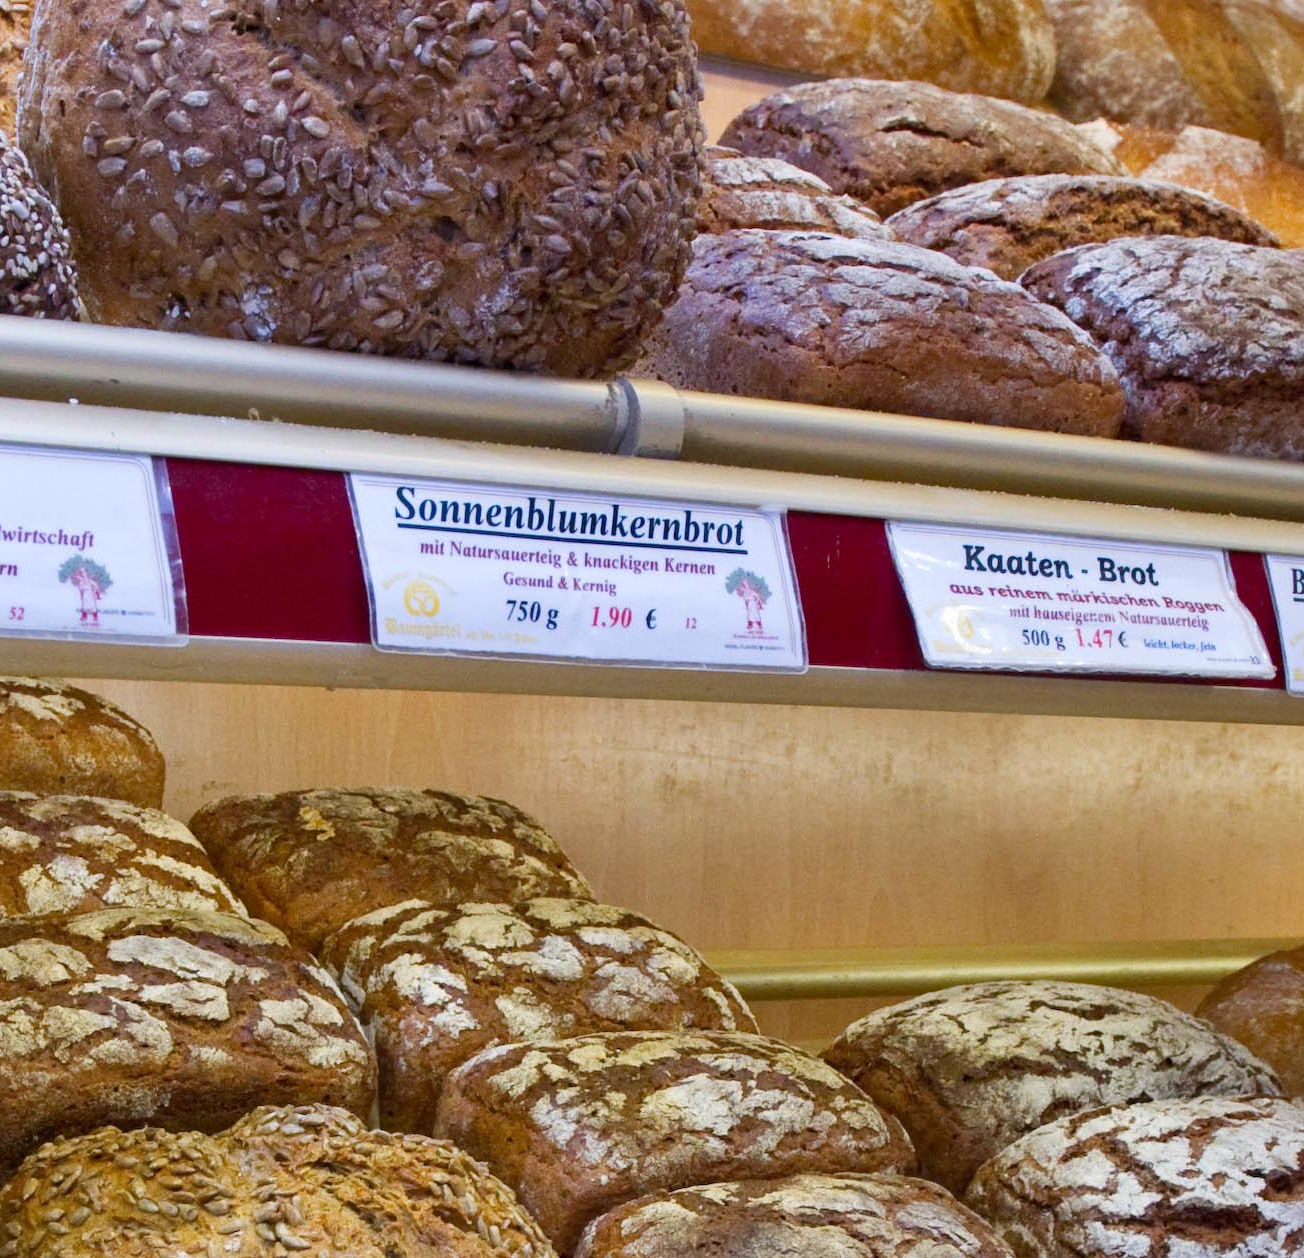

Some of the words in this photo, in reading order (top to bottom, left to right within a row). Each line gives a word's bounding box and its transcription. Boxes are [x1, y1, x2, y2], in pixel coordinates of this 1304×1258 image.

[395, 486, 744, 546] Sonnenblumkernbrot
[420, 539, 445, 556] mit
[450, 540, 562, 568] Natursauerteig
[567, 551, 578, 567] &
[584, 552, 659, 575] knackigen
[664, 557, 716, 575] Kernen
[963, 544, 1074, 580] Kaaten
[1097, 557, 1159, 586] Brot
[503, 571, 553, 589] Gesund
[558, 577, 569, 590] &
[573, 577, 617, 596] Kernig
[950, 584, 984, 596] aus
[989, 585, 1053, 601] reinem
[1056, 589, 1160, 608] märkischen
[1162, 596, 1225, 613] Roggen
[9, 606, 25, 621] 52
[506, 599, 541, 623] 750
[546, 608, 559, 630] g
[591, 606, 633, 629] 1.90
[645, 608, 657, 630] €
[685, 617, 697, 630] 12
[1009, 604, 1030, 618] mit
[1119, 611, 1210, 632] Natursauerteig
[1022, 628, 1050, 646] 500
[1054, 635, 1066, 650] g
[1075, 627, 1113, 648] 1.47
[1118, 631, 1128, 648] €
